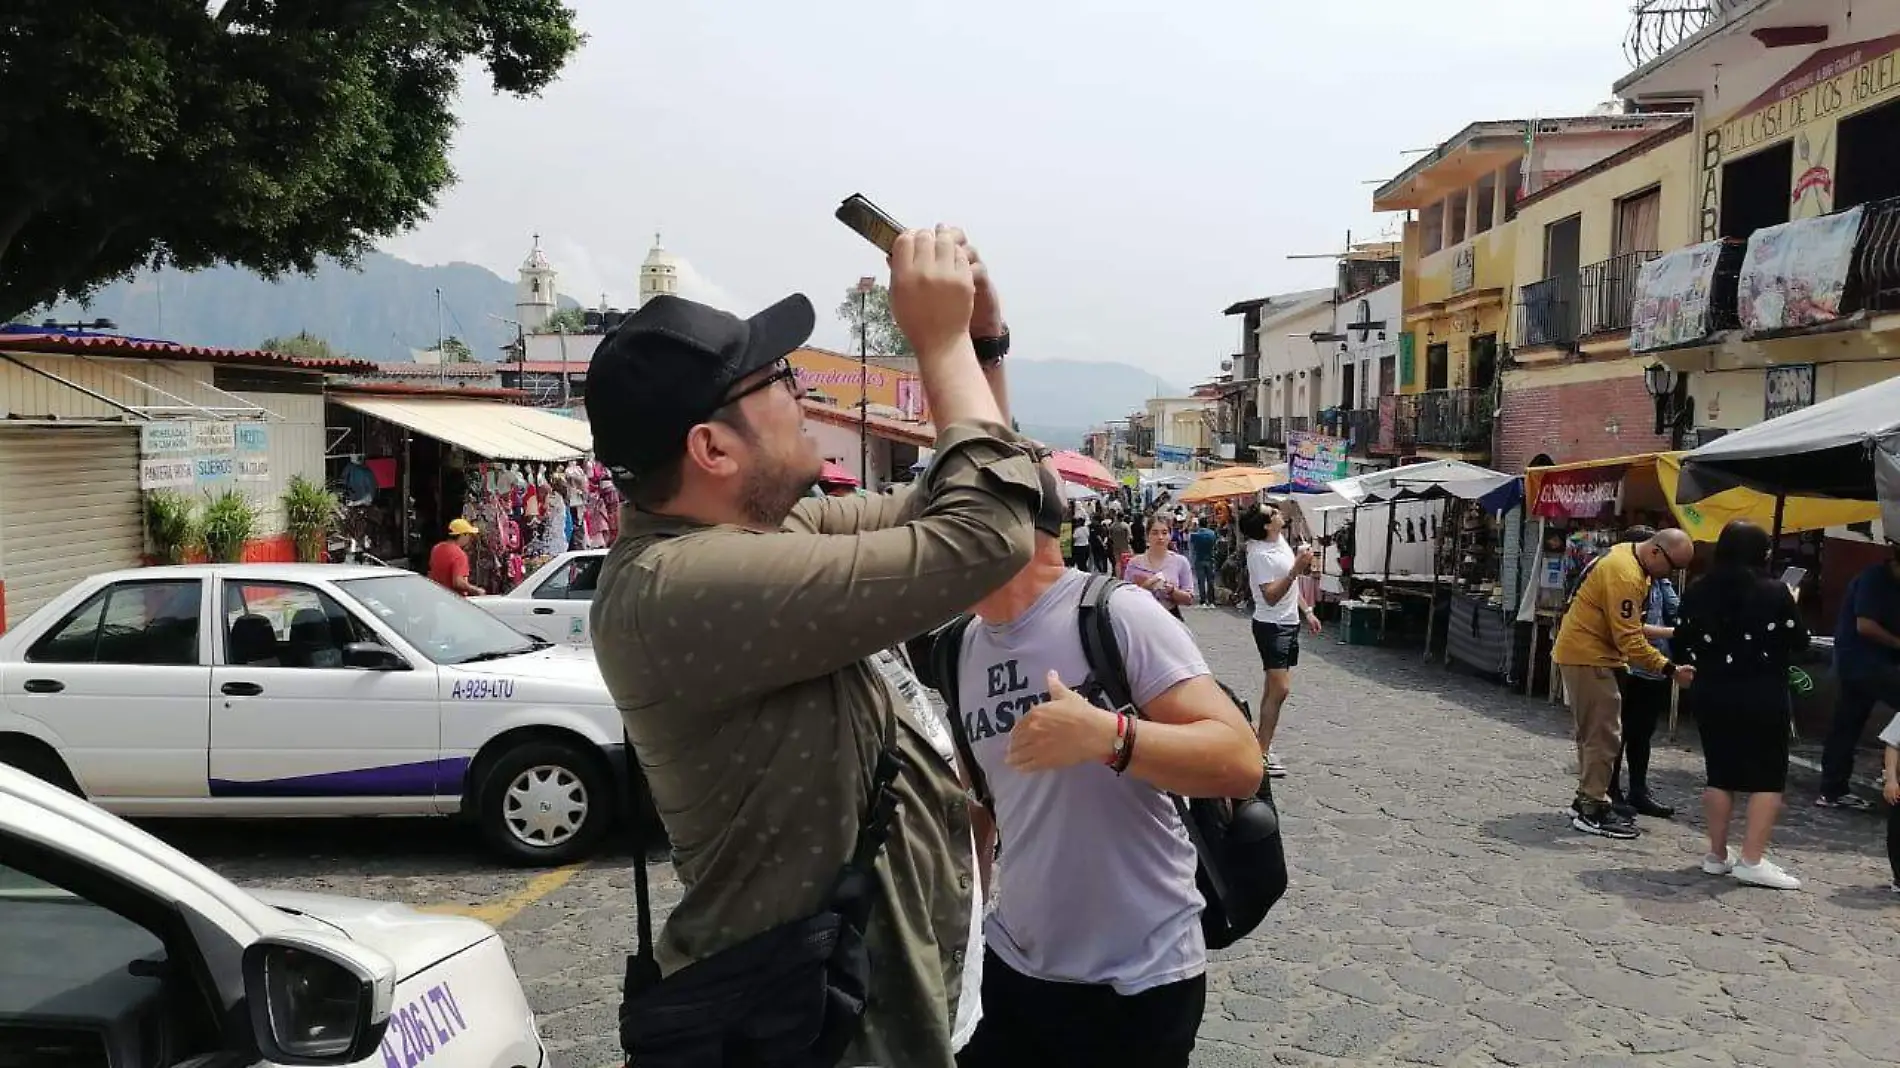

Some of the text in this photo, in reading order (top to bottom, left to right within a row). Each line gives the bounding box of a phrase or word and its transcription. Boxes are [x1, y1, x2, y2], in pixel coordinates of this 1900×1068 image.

[1750, 104, 1783, 142] CASA
[1789, 91, 1809, 126] DE
[1814, 77, 1843, 117] LOS
[1700, 129, 1721, 243] BAR
[198, 459, 232, 476] SUEROS
[1621, 598, 1633, 619] 9
[452, 679, 514, 699] A-929-LTU
[987, 659, 1028, 698] EL
[381, 981, 467, 1068] A 206 LTV
